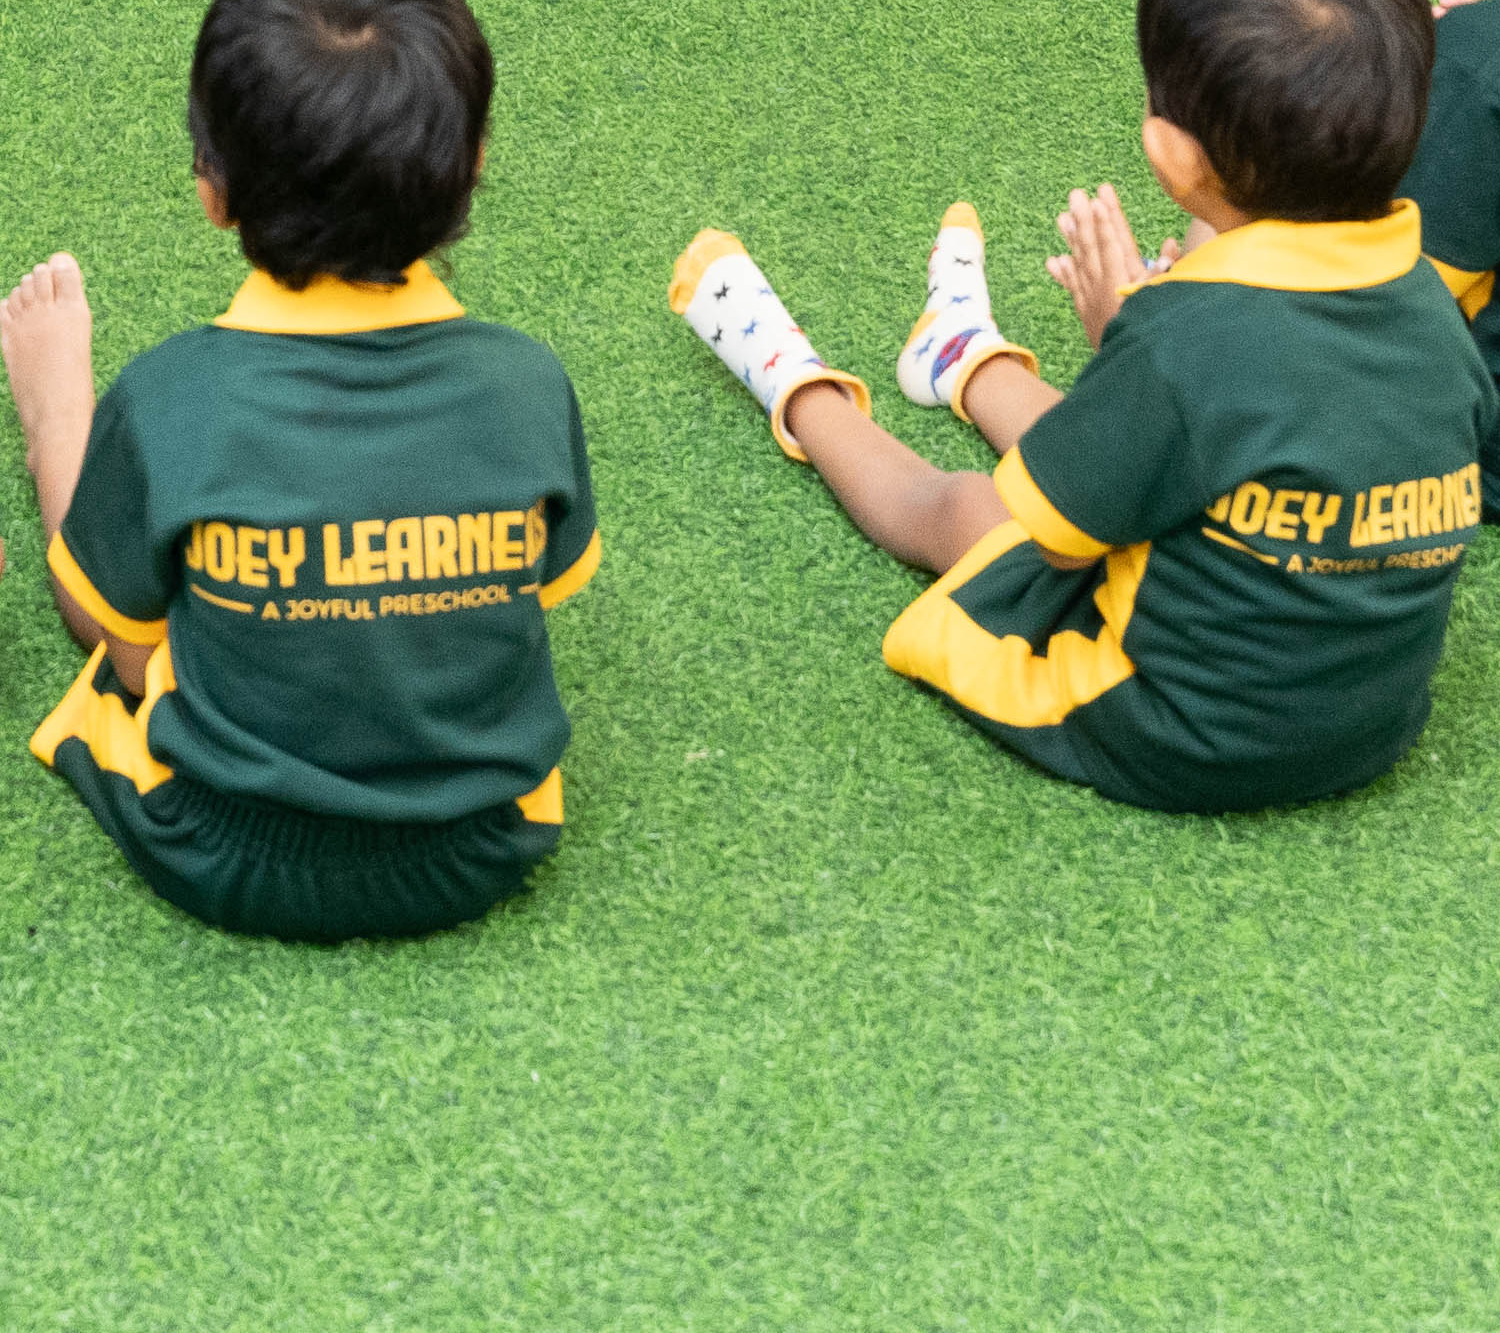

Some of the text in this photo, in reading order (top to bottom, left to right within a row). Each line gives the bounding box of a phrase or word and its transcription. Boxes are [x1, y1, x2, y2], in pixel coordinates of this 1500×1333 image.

[185, 519, 306, 589] JOEY
[1286, 553, 1305, 574] A
[261, 583, 512, 621] A JOYFUL PRESCHOOL
